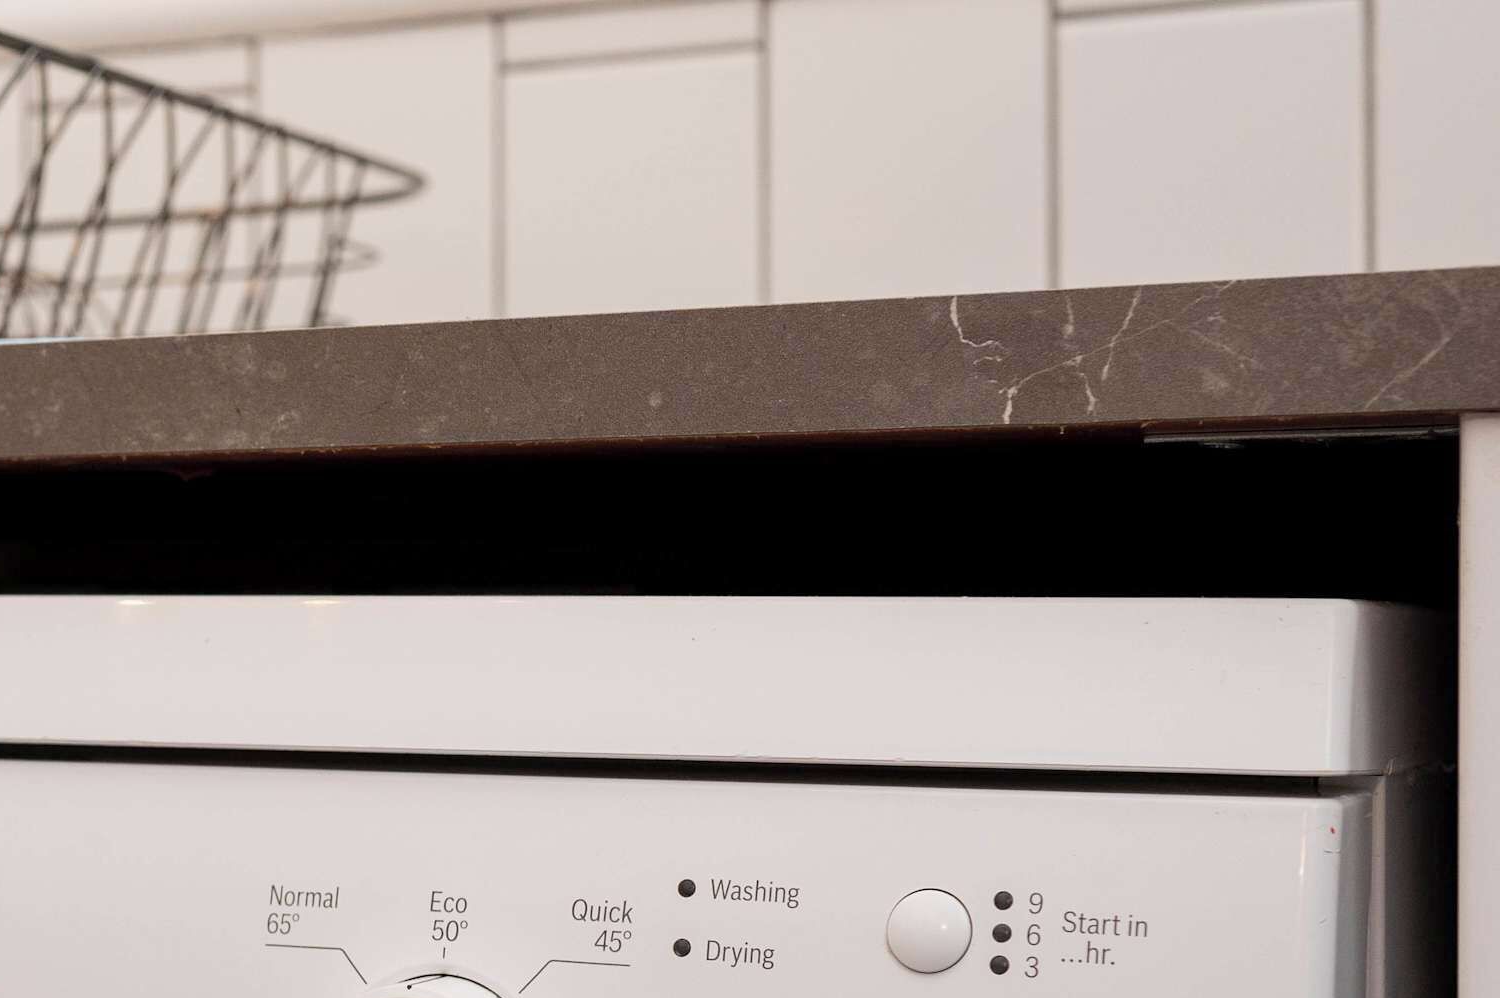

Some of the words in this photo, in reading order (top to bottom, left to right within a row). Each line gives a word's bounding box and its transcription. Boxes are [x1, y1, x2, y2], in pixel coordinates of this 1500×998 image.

[269, 885, 340, 908] Normal
[429, 891, 468, 913] Eco
[710, 879, 801, 908] Washing
[1028, 892, 1044, 914] 9
[571, 899, 634, 924] Quick
[1026, 924, 1042, 946] 6
[1061, 911, 1122, 936] Start
[1127, 915, 1149, 937] in
[705, 940, 776, 970] Drying
[1023, 956, 1040, 978] 3
